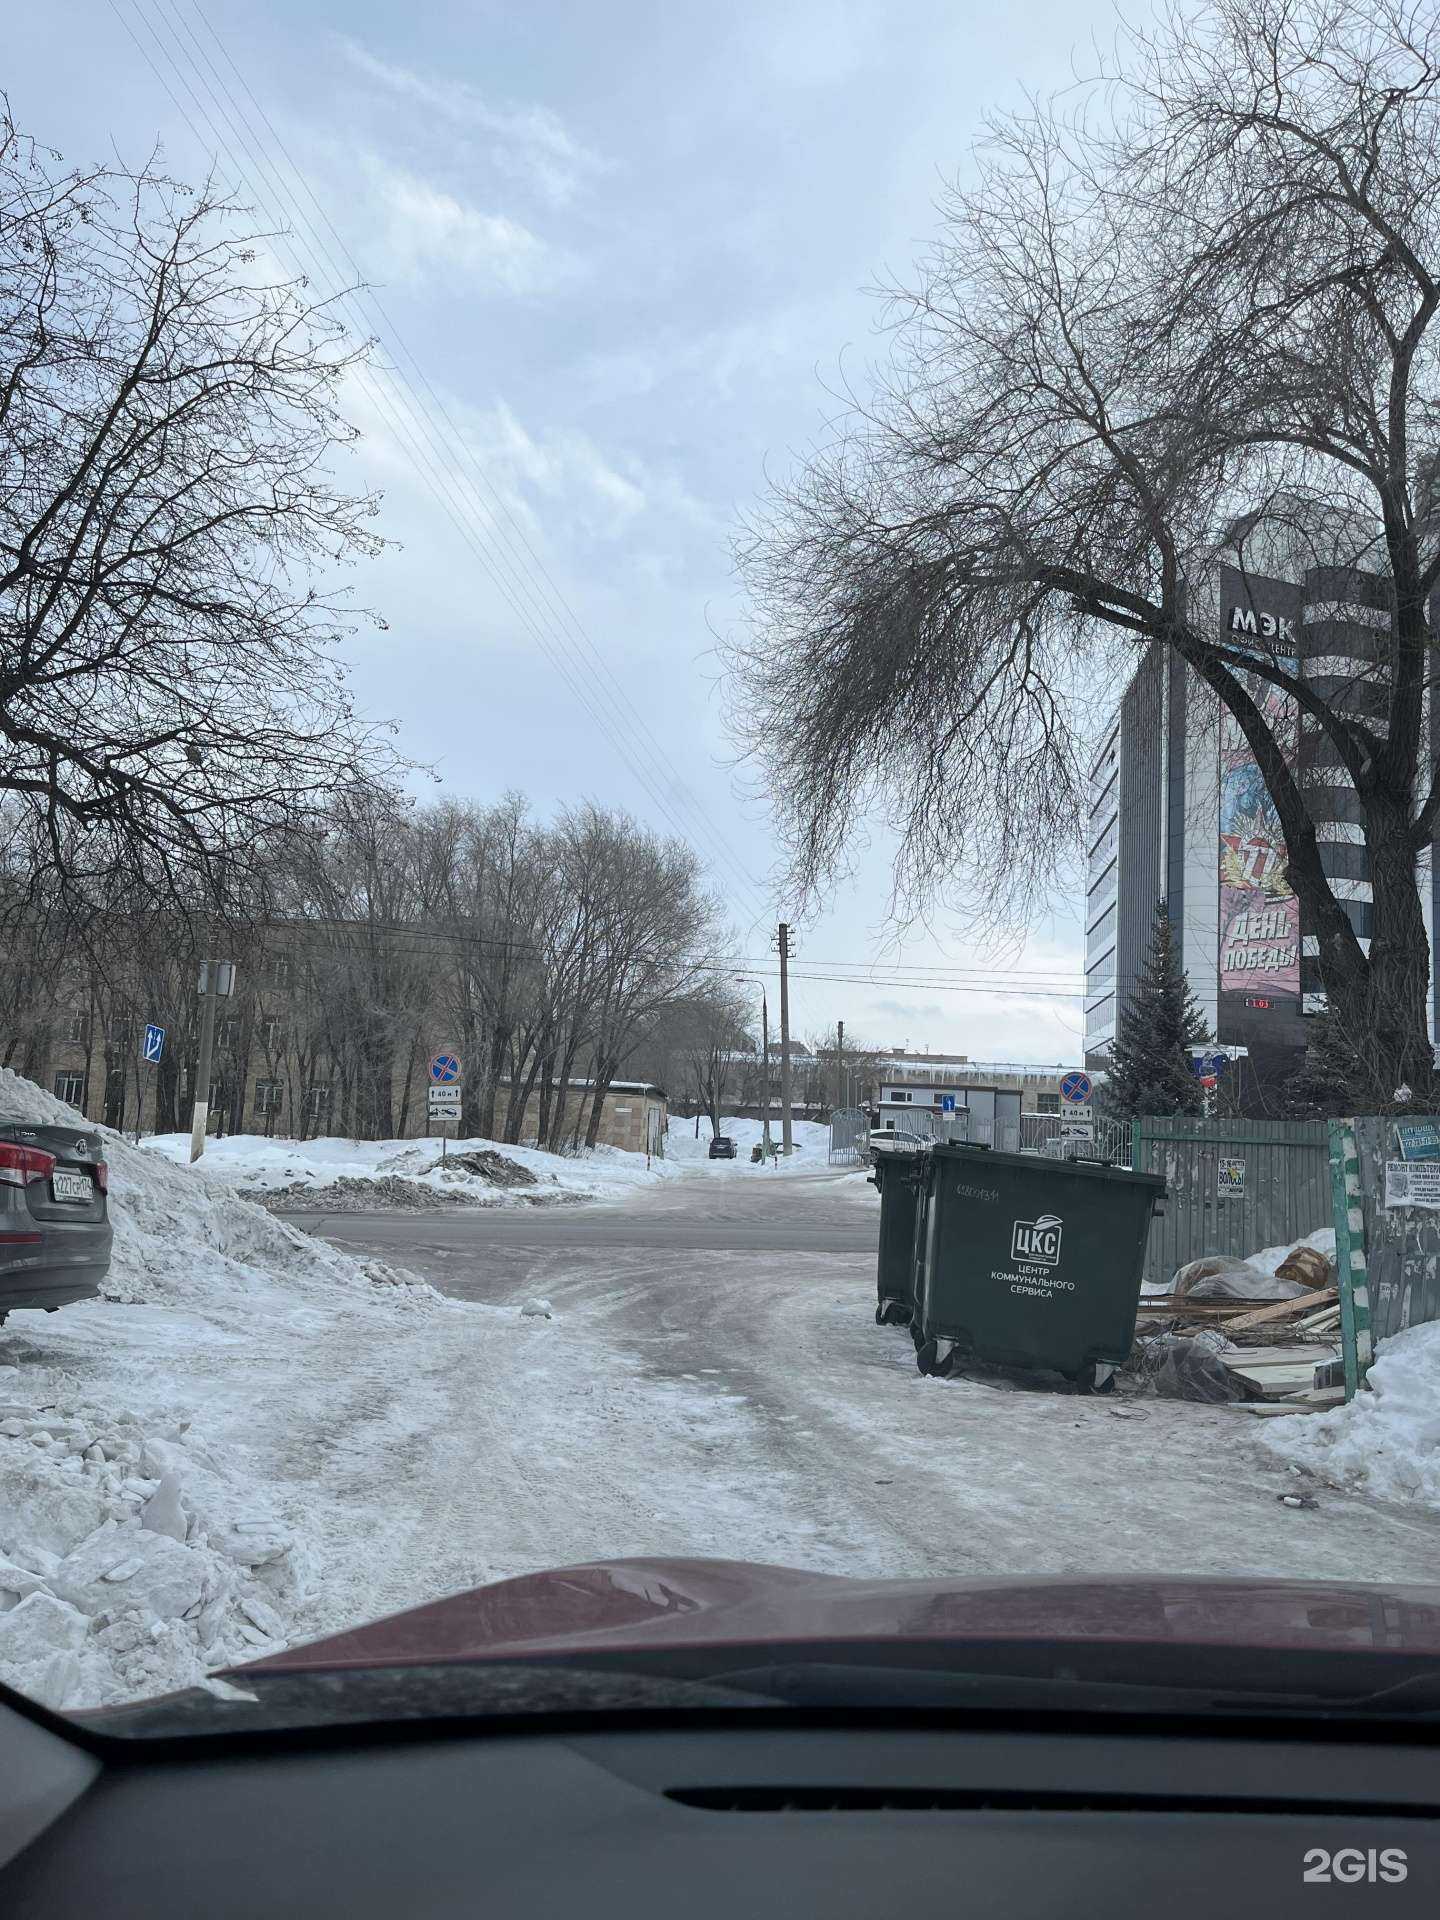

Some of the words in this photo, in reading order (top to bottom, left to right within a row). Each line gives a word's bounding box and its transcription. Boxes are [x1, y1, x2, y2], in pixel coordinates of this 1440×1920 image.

[1232, 606, 1297, 643] МЭК
[1227, 910, 1292, 947] ДЕНЬ
[1223, 945, 1297, 973] ПОБЕДЫ
[1016, 1228, 1057, 1255] ЦКС
[991, 1271, 1076, 1291] КОММУНАЛЬНОГО
[1018, 1264, 1050, 1276] ЦЕНТР
[1010, 1284, 1053, 1298] СЕРВИСА
